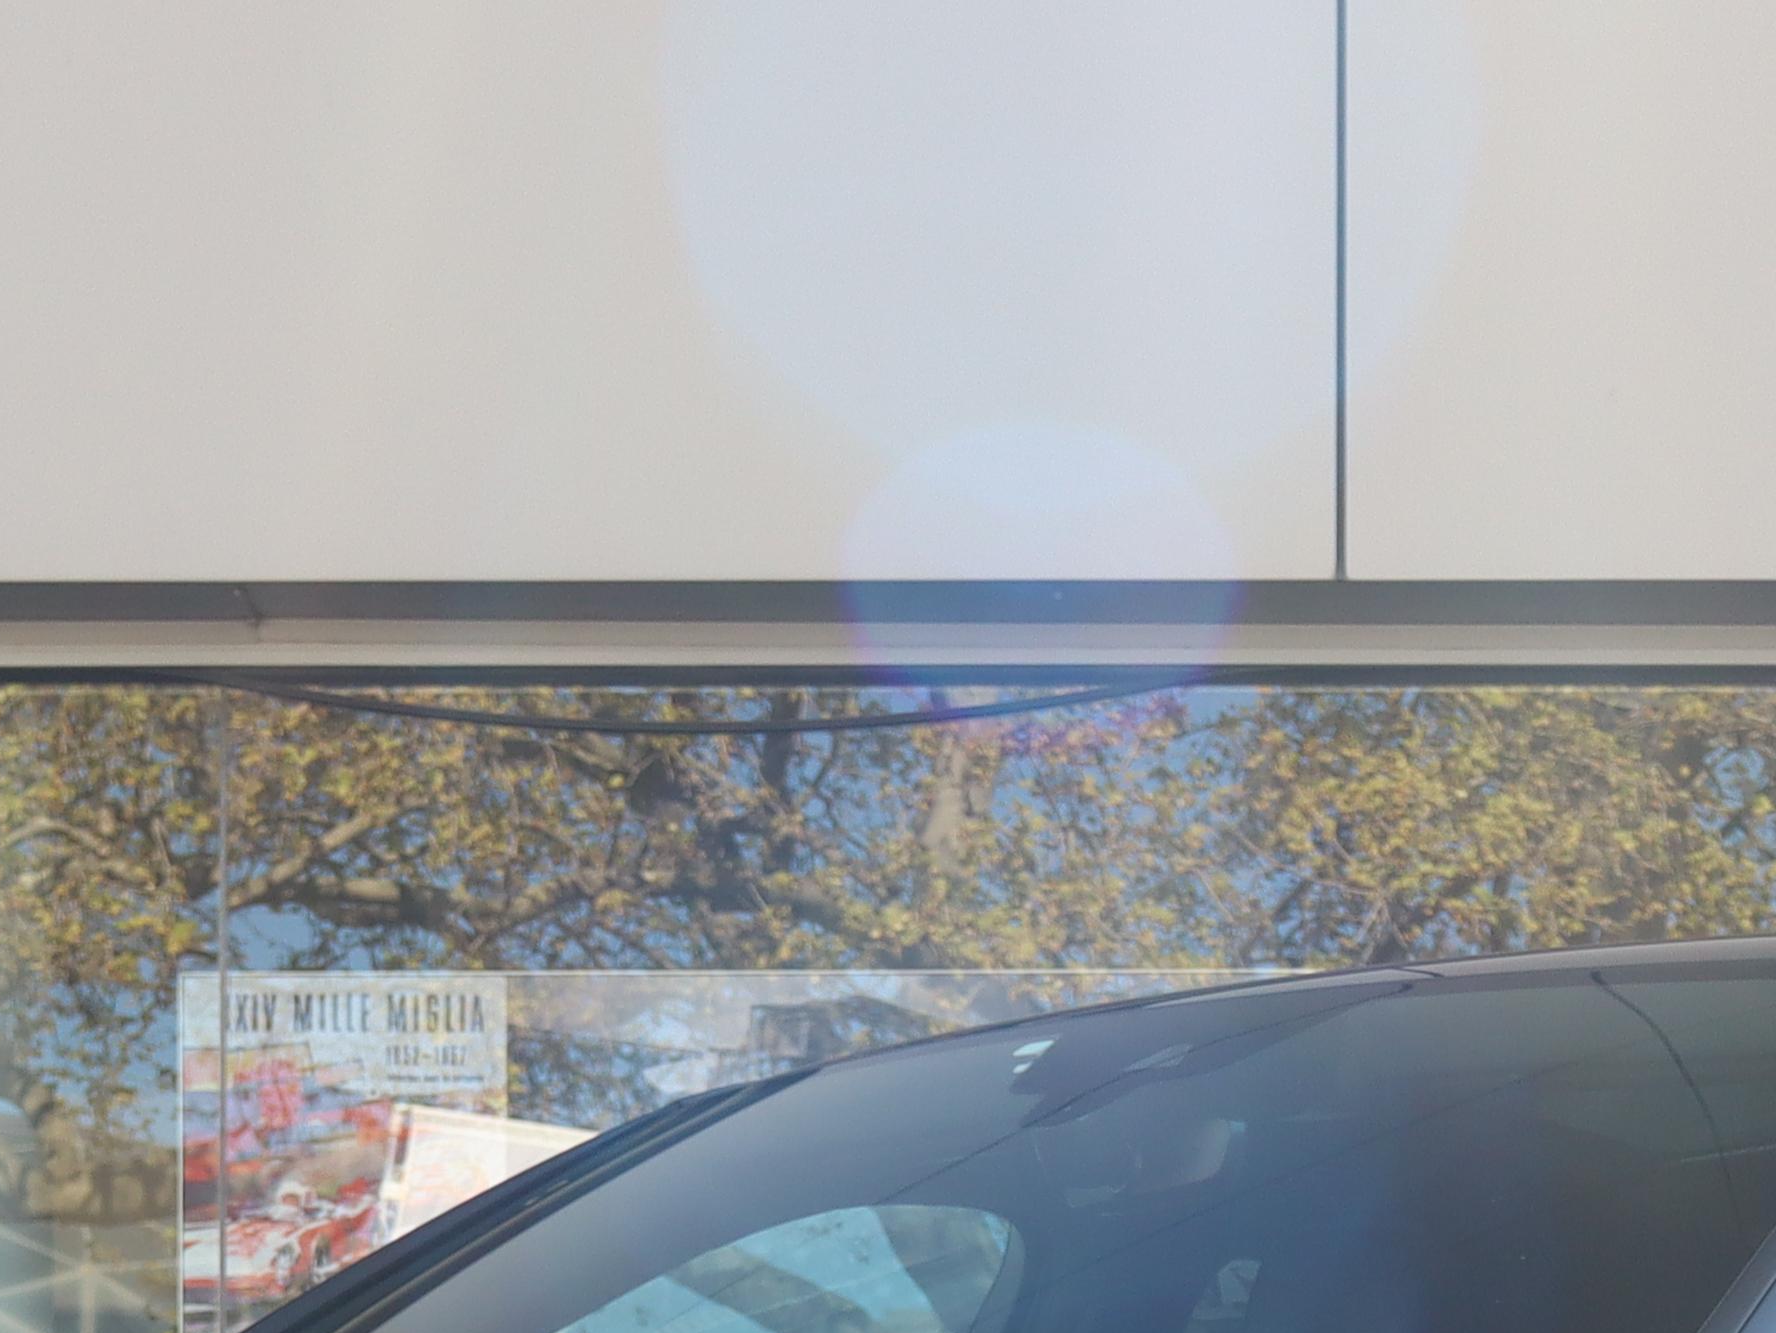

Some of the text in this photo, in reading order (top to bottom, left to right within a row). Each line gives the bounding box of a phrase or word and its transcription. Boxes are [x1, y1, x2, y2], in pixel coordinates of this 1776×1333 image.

[224, 993, 485, 1033] XIV MILLE MIGLIA
